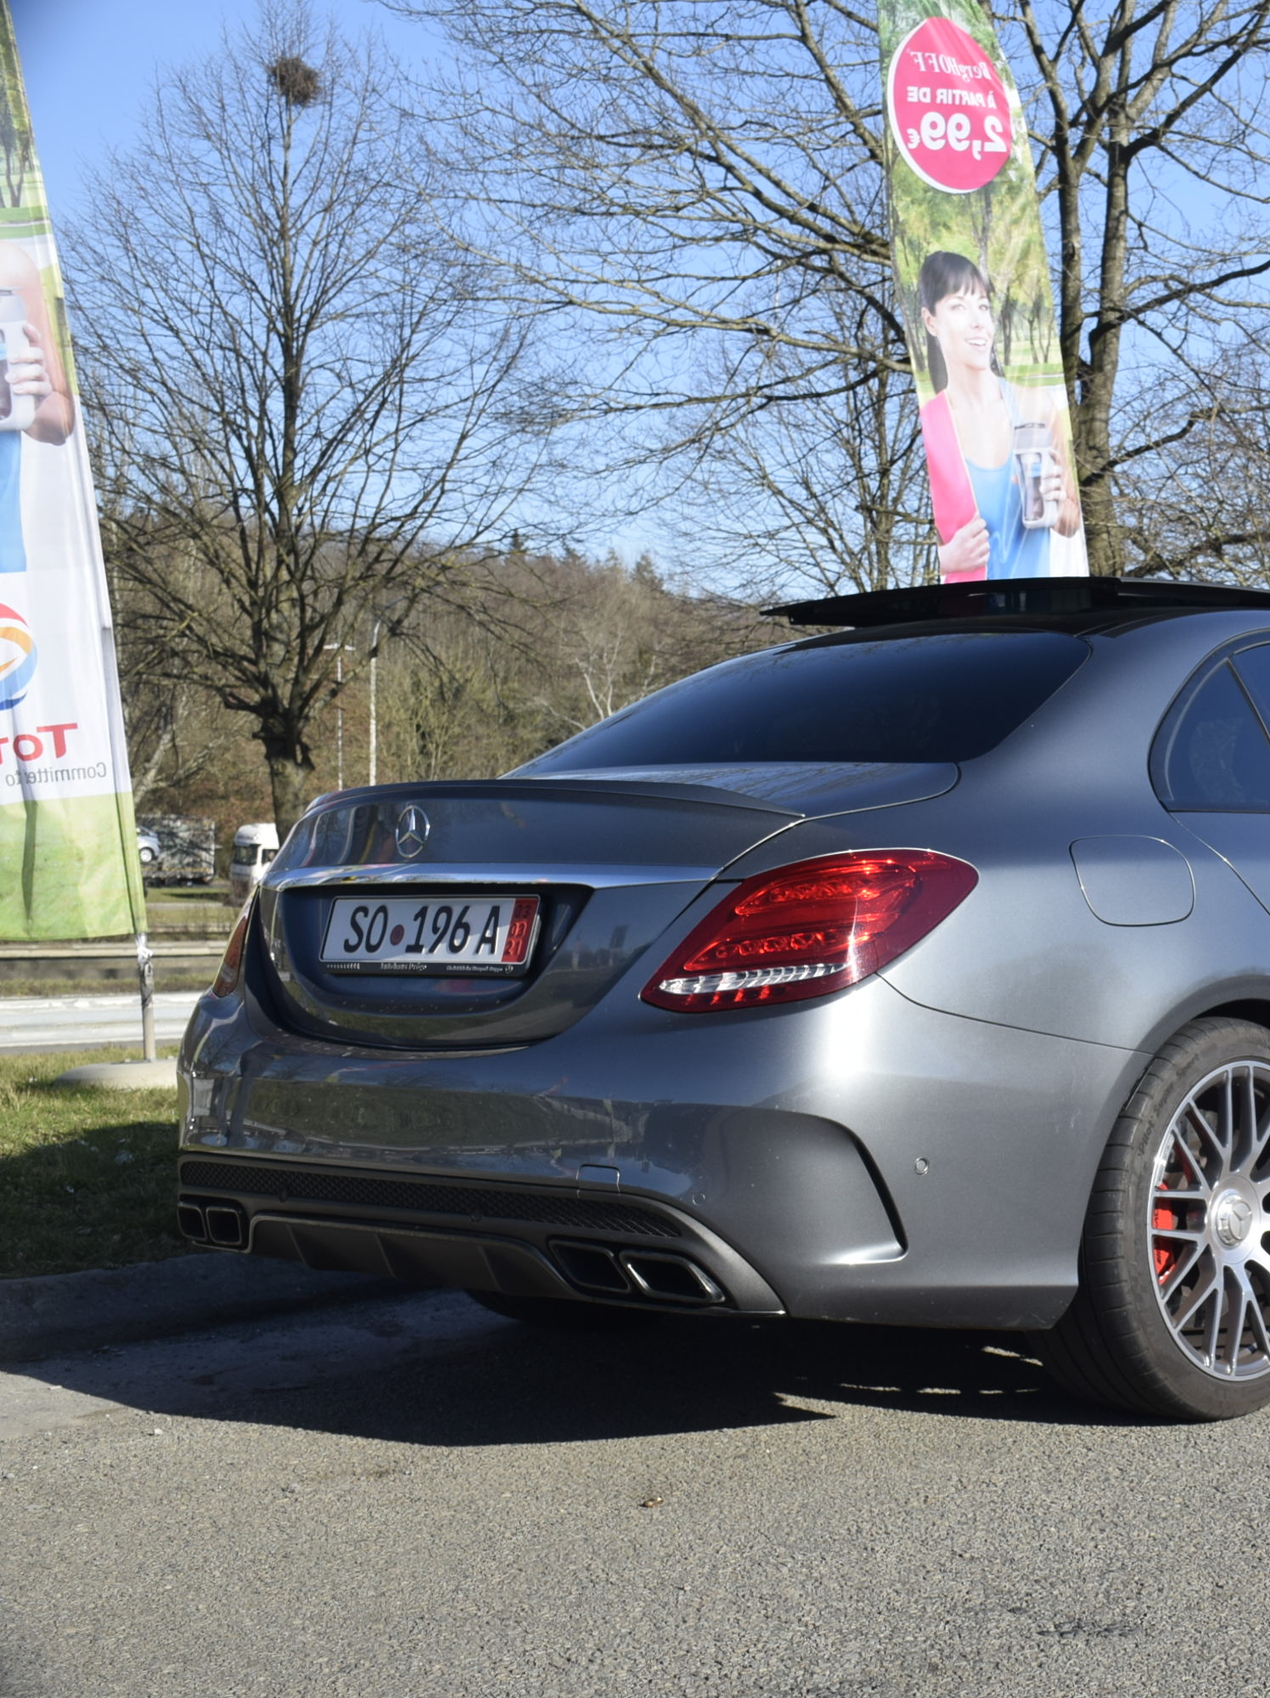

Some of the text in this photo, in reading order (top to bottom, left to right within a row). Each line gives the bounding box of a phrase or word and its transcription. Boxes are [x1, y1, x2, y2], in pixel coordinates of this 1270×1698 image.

[343, 904, 501, 955] SO 196 A
